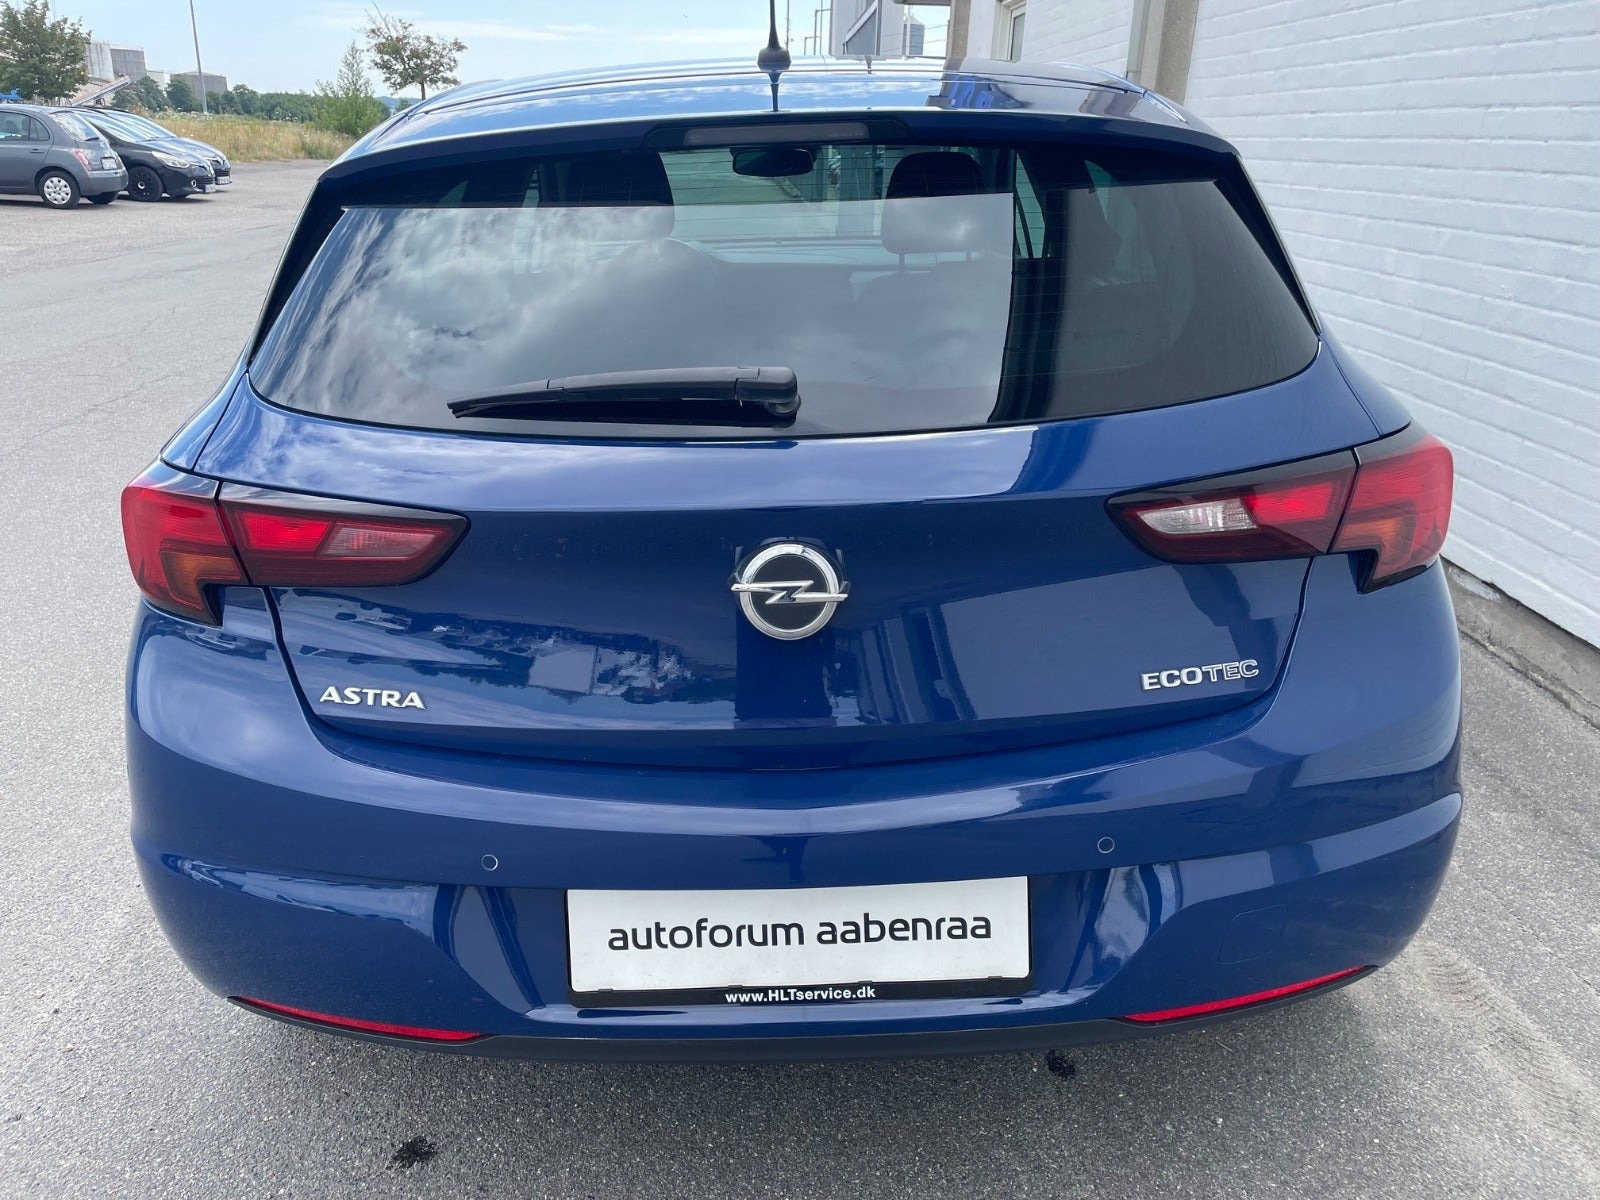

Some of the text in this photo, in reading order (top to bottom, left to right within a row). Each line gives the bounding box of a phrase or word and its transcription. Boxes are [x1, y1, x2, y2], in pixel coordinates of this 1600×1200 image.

[1141, 659, 1260, 690] ECOTEC
[319, 685, 426, 709] ASTRA
[608, 912, 992, 950] autoforum aabenraa
[725, 986, 876, 1003] www.HLTservice.dk
